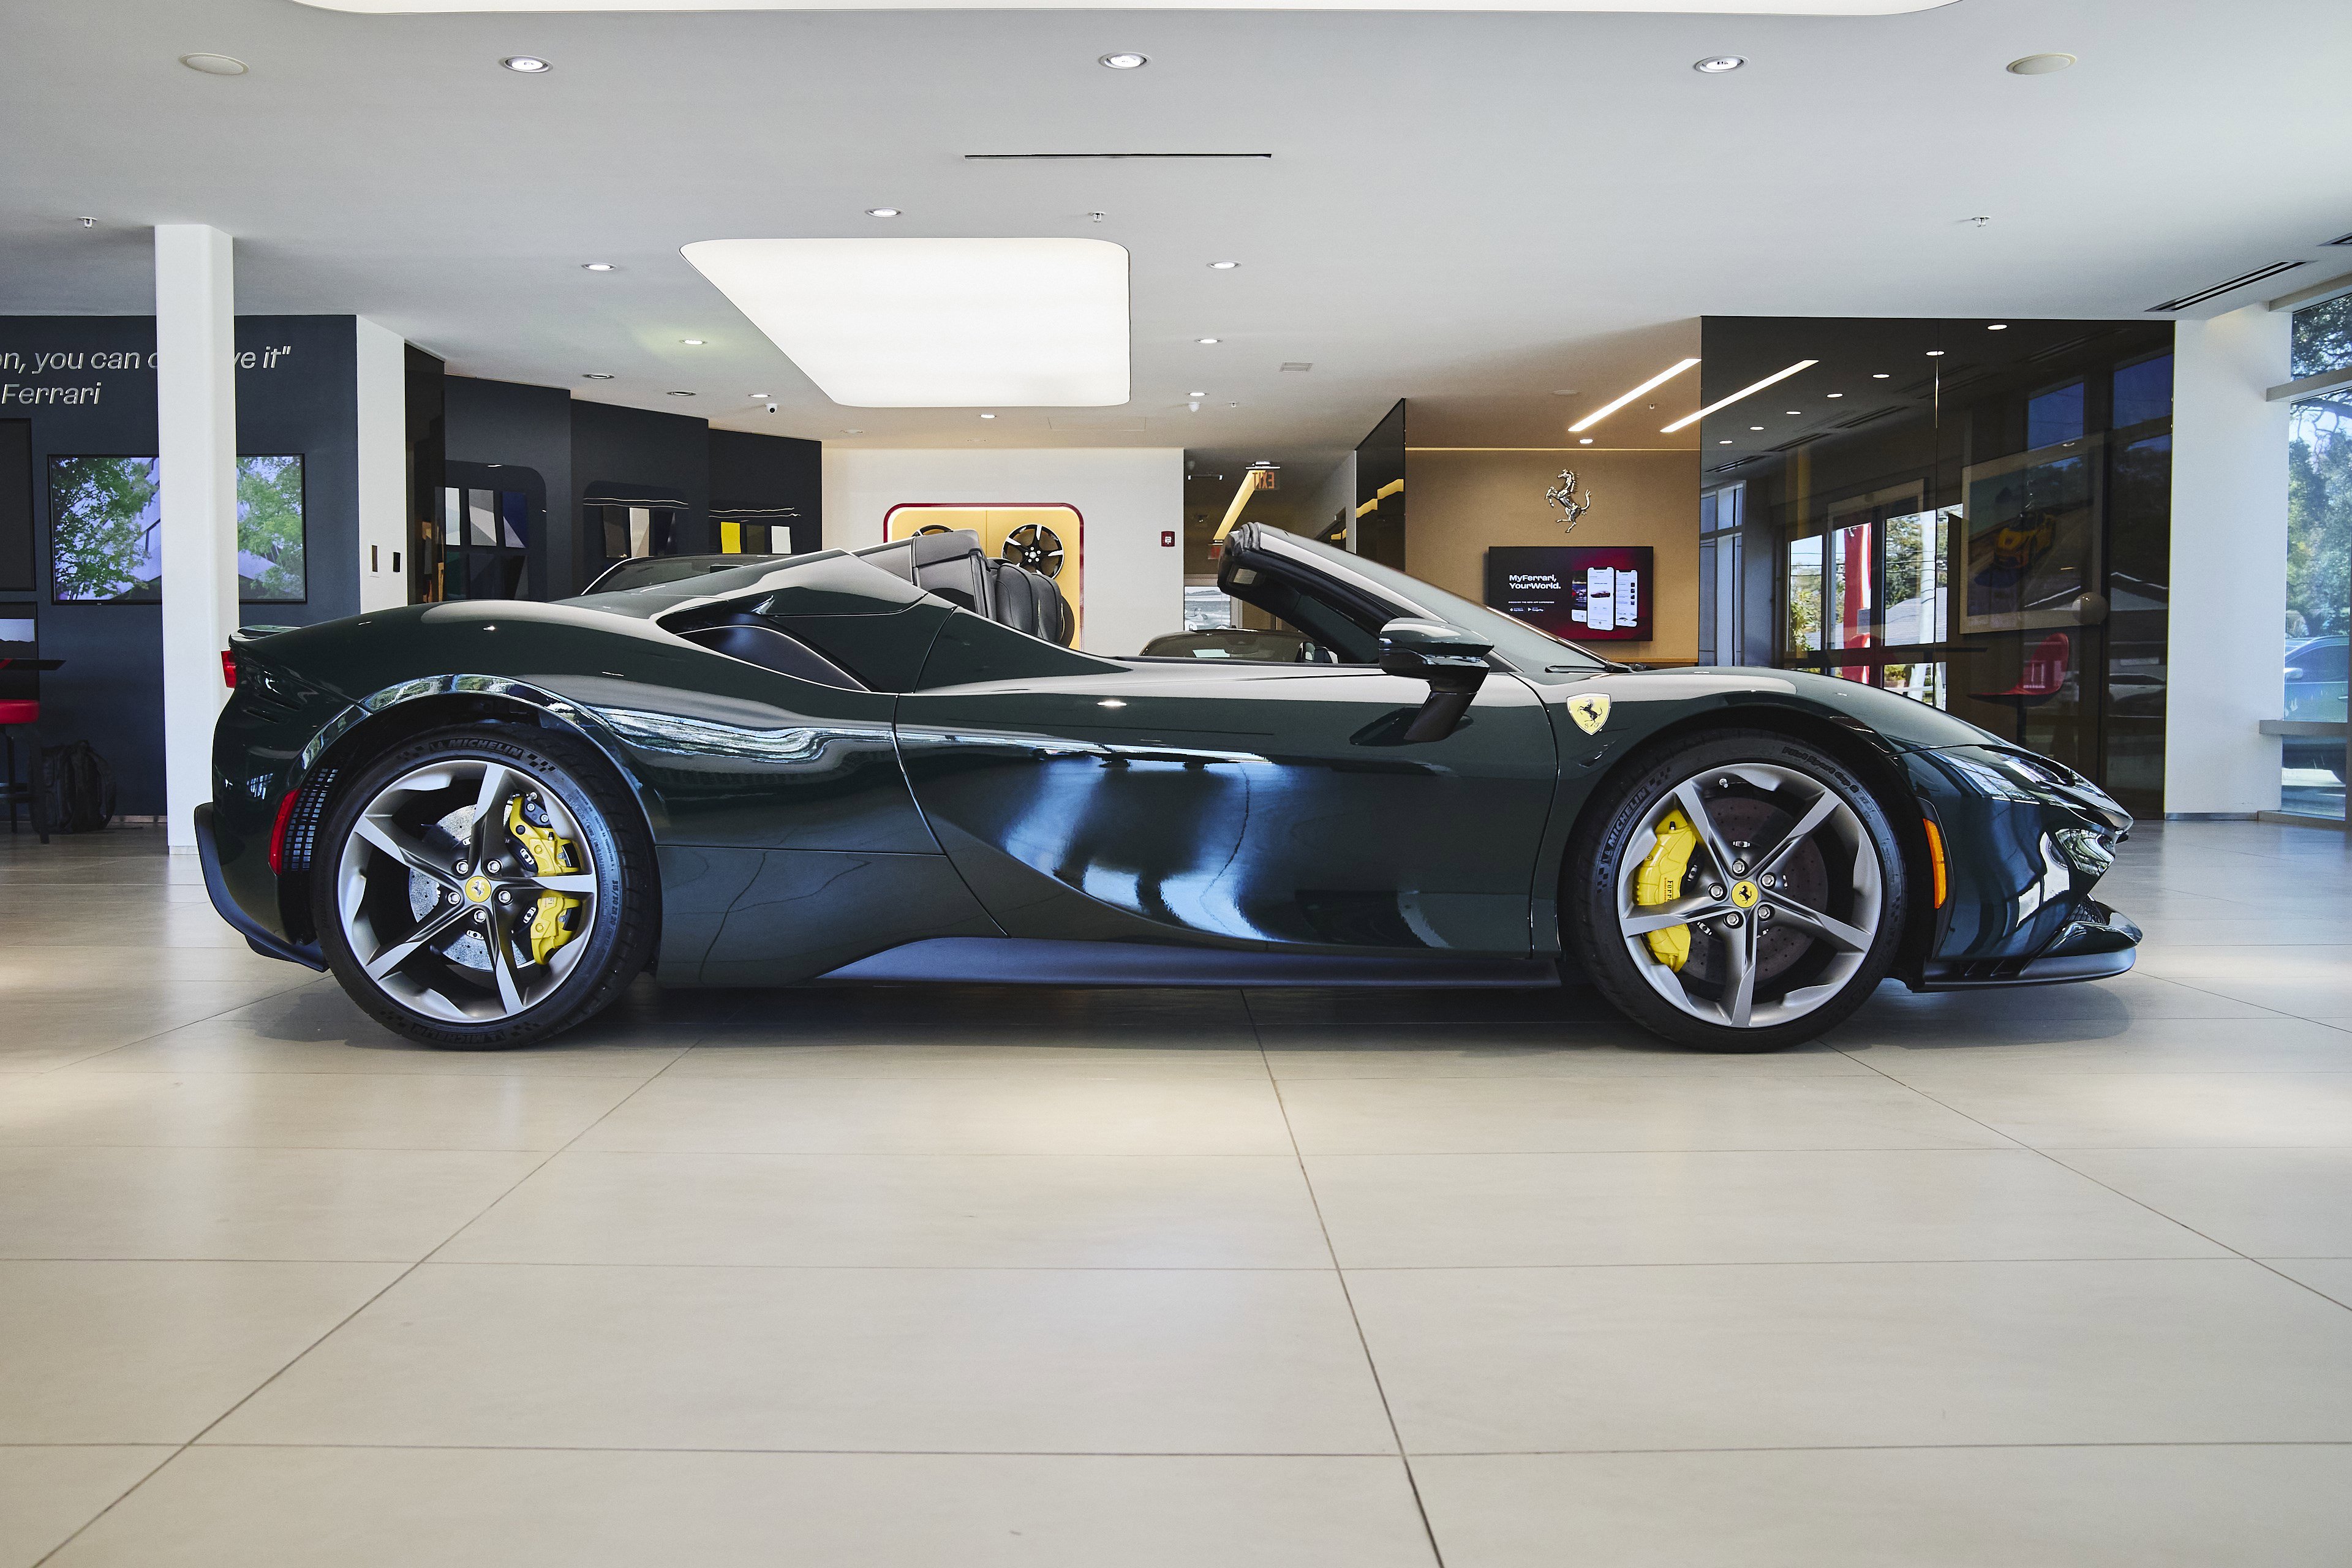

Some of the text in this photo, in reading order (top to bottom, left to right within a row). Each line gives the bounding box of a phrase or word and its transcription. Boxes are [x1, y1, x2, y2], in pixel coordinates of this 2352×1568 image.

[32, 352, 84, 374] you
[91, 352, 141, 369] can
[263, 345, 292, 369] it"
[1, 382, 102, 404] Ferrari
[1509, 574, 1557, 582] MyFerrari,
[448, 739, 522, 757] MICHELIN
[1607, 788, 1648, 847] MICHELIN
